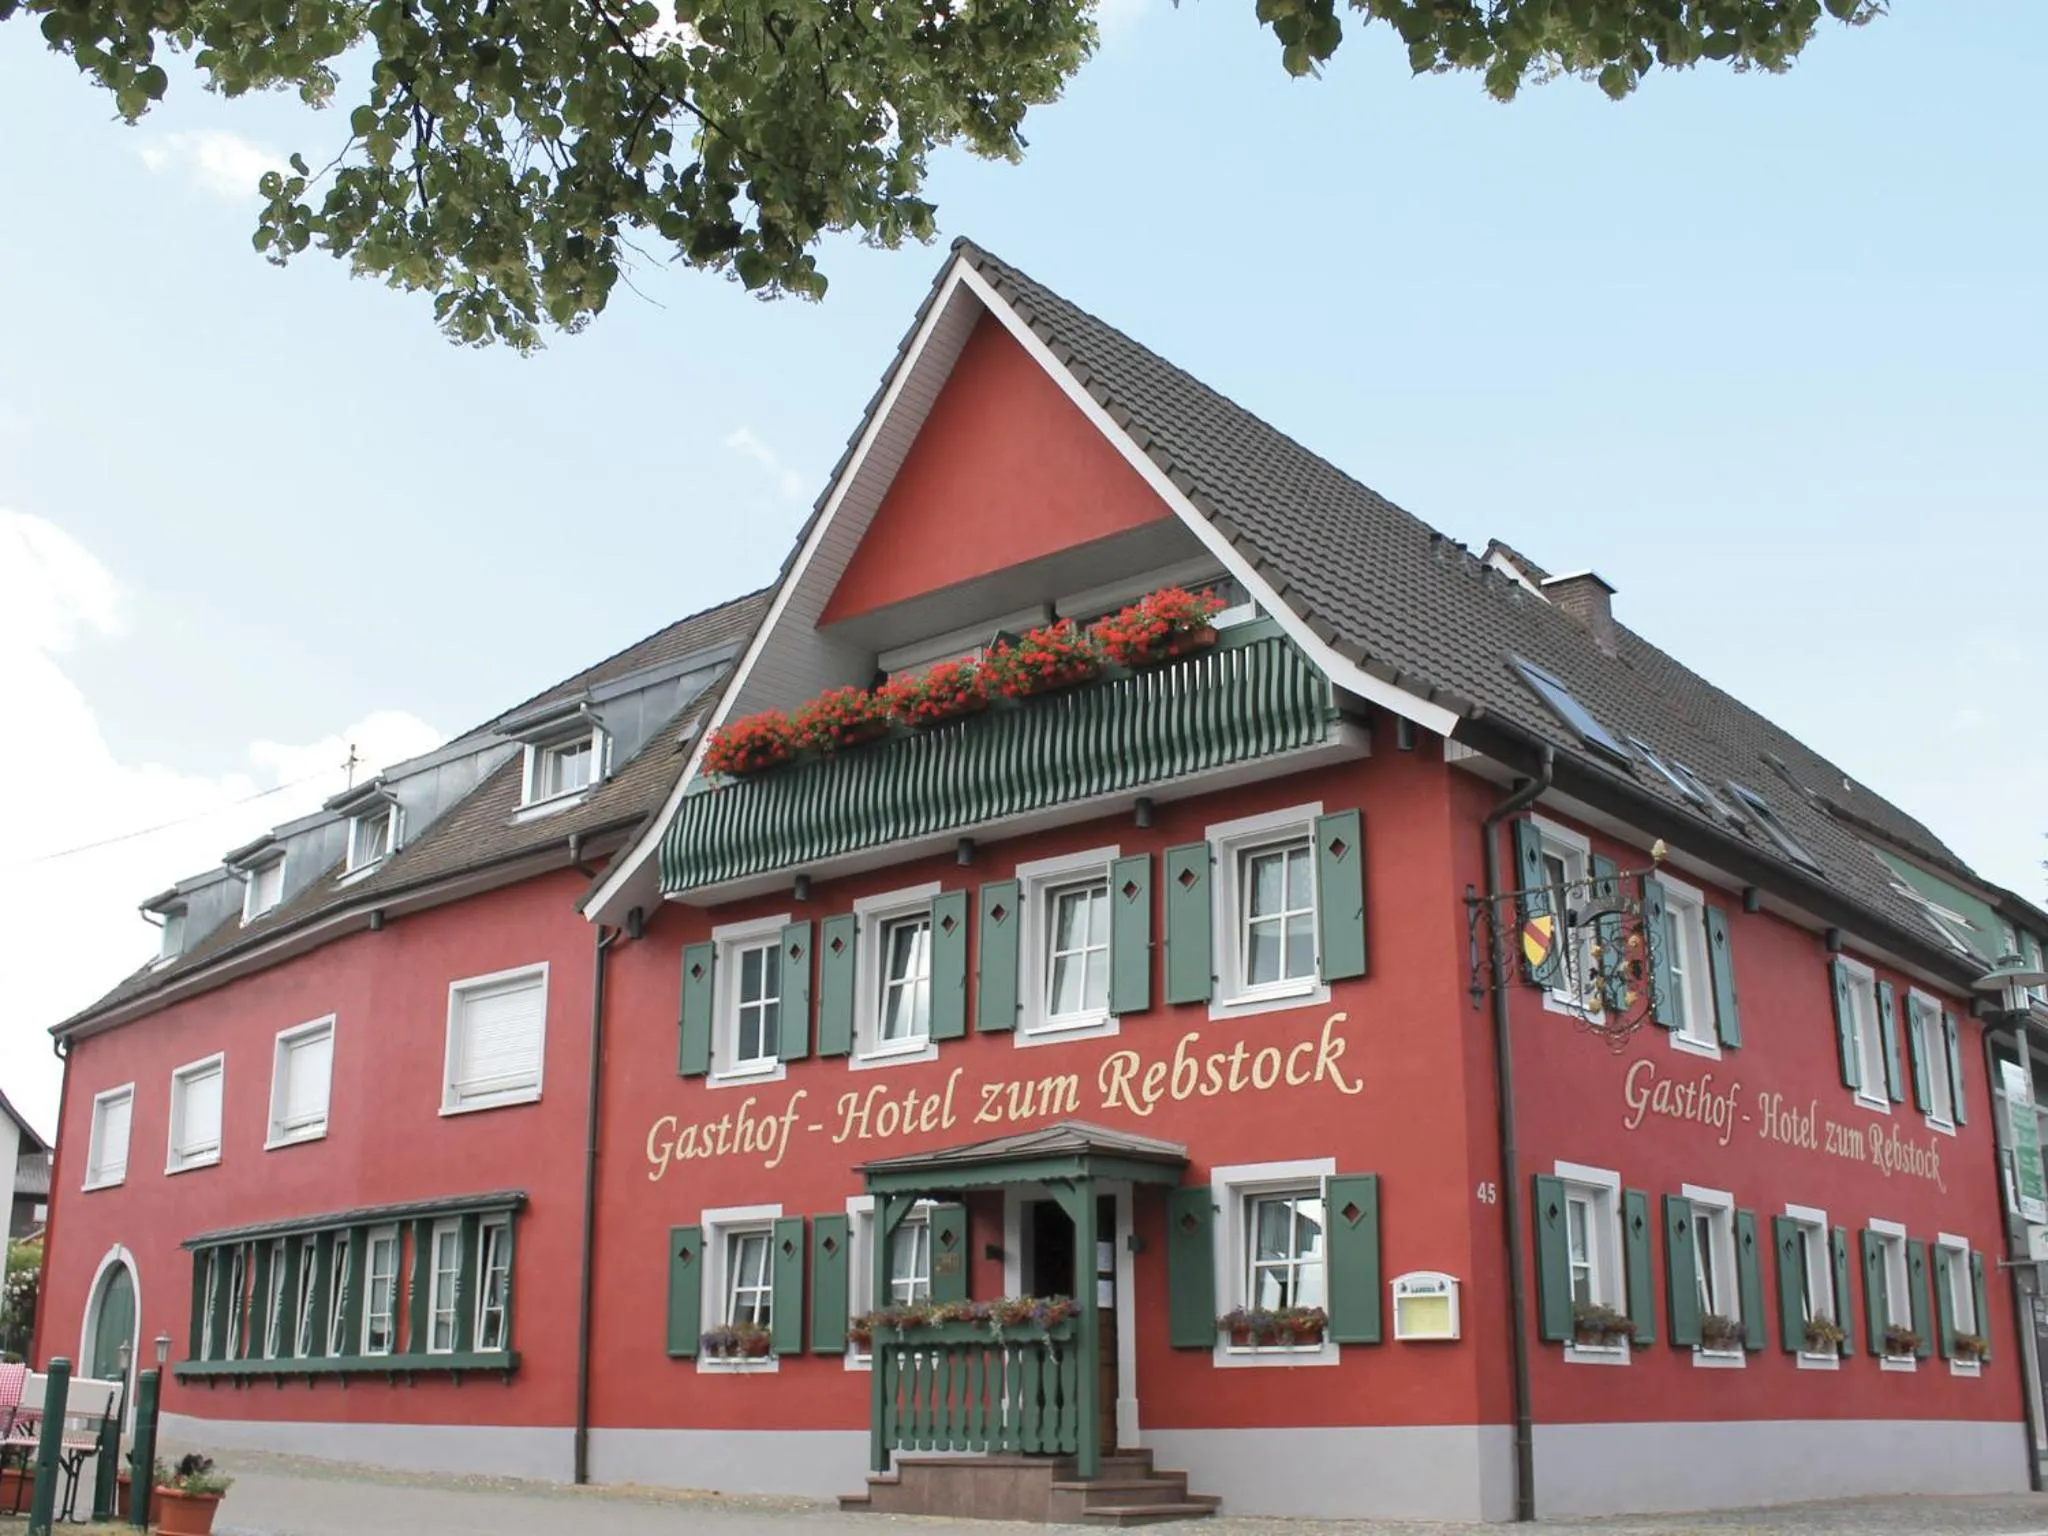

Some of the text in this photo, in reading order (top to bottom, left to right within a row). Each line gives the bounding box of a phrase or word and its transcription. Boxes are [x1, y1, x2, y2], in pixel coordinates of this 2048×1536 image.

[646, 1089, 807, 1181] Gasthof
[832, 1067, 963, 1144] Hotel
[973, 1074, 1081, 1124] zum
[1098, 1012, 1364, 1117] Rebstock
[1624, 1059, 1741, 1147] Gasthof
[1758, 1091, 1819, 1150] Hotel
[1824, 1119, 1867, 1162] zum
[1869, 1122, 1947, 1194] Rebstock
[1476, 1181, 1497, 1205] 45
